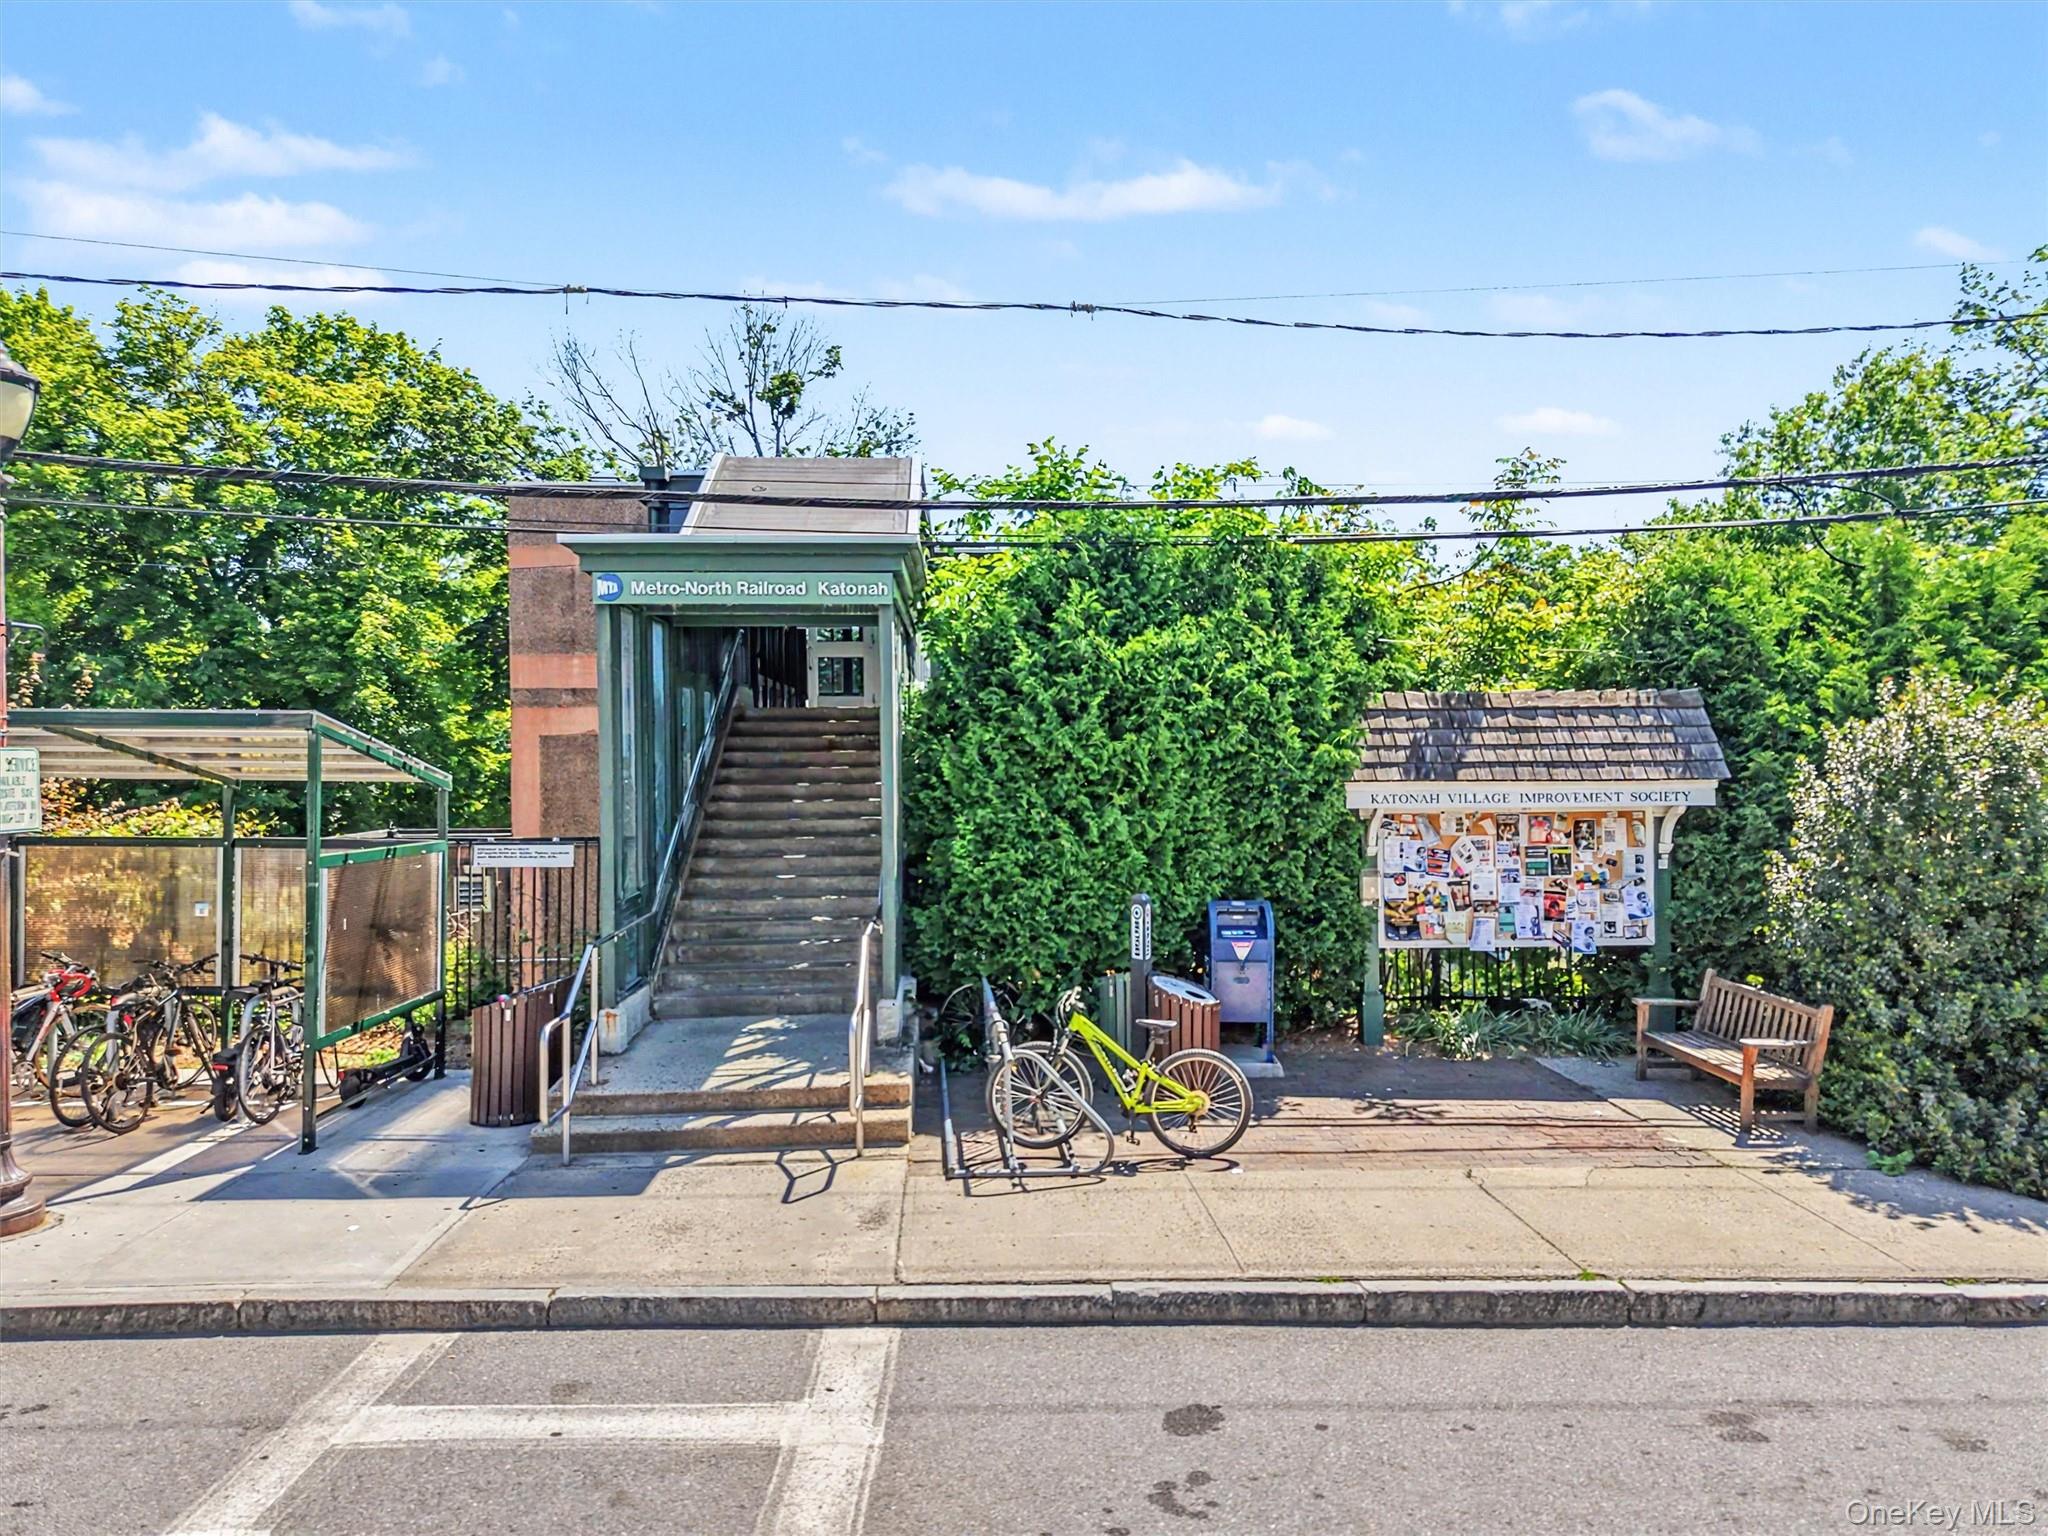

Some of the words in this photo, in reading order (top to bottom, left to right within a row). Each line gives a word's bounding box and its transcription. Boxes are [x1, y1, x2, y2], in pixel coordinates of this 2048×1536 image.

[630, 580, 732, 596] Metro-North
[736, 580, 807, 596] Railroad
[817, 580, 889, 596] Katonah
[1370, 793, 1440, 804] KATONAH
[1447, 793, 1511, 804] VILLAGE
[1519, 792, 1625, 804] IMPROVEMENT
[1630, 791, 1692, 802] SOCIETY
